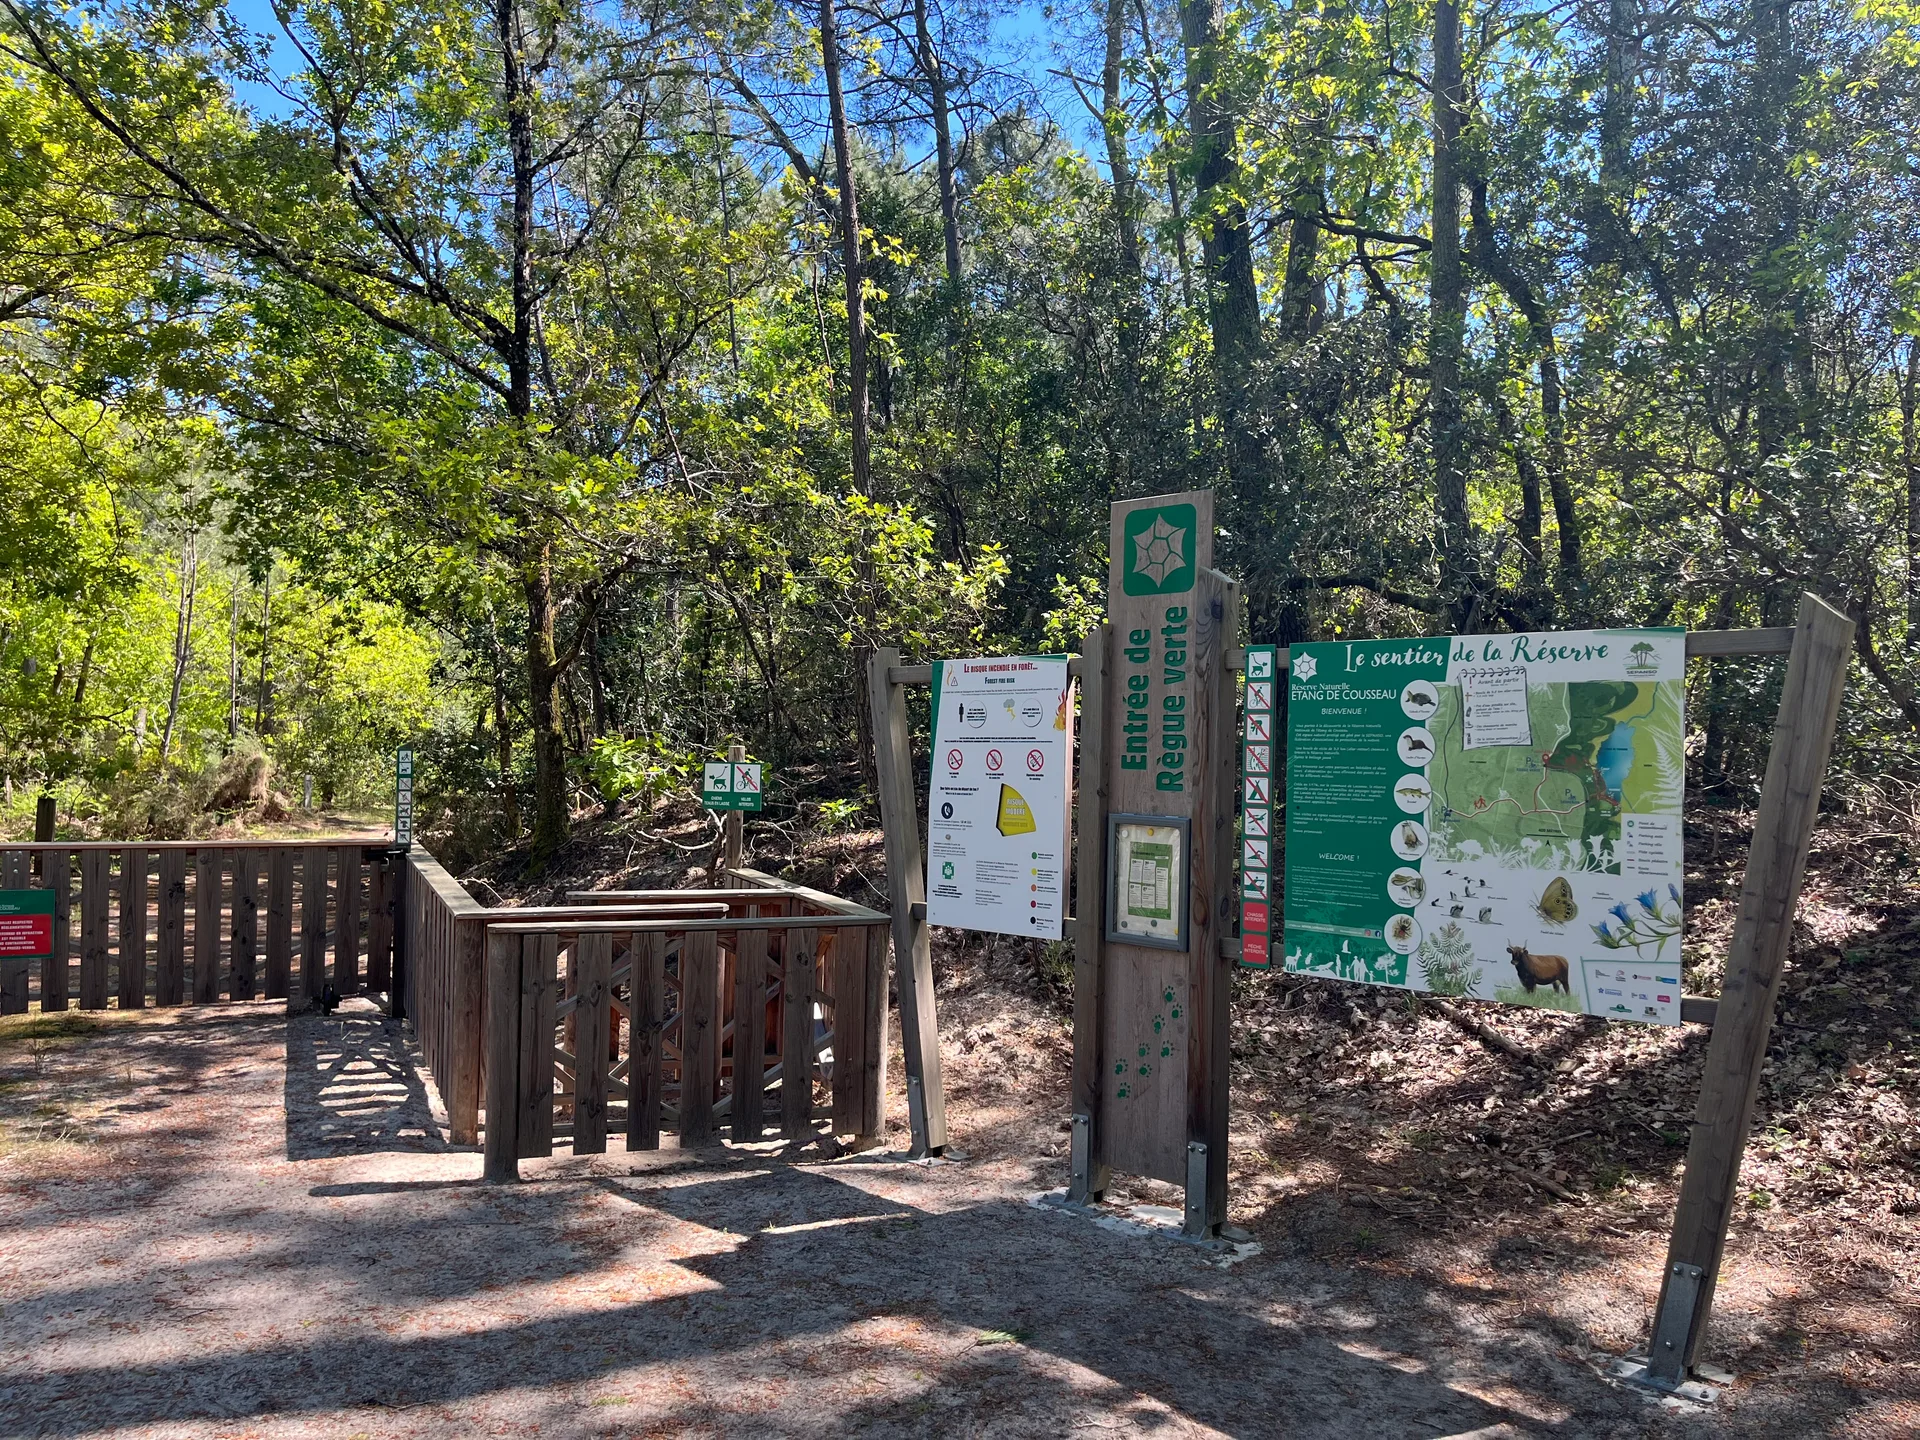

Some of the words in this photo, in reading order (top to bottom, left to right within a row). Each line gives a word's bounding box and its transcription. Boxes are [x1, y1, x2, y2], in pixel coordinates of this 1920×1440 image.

[1124, 628, 1150, 663] de
[1161, 606, 1188, 684] verte
[1344, 644, 1365, 672] Le
[1371, 645, 1444, 667] sentier
[1453, 642, 1474, 662] de
[1483, 640, 1503, 661] la
[1510, 636, 1609, 663] Réserve
[971, 664, 987, 672] RISQUE
[989, 664, 1010, 672] INCENDIE
[1292, 690, 1323, 700] ETANG
[1327, 690, 1339, 700] DE
[1343, 689, 1396, 700] COUSSEAU
[1121, 674, 1149, 770] Entrée
[1156, 695, 1187, 792] Règue
[1319, 853, 1355, 861] WELCOME
